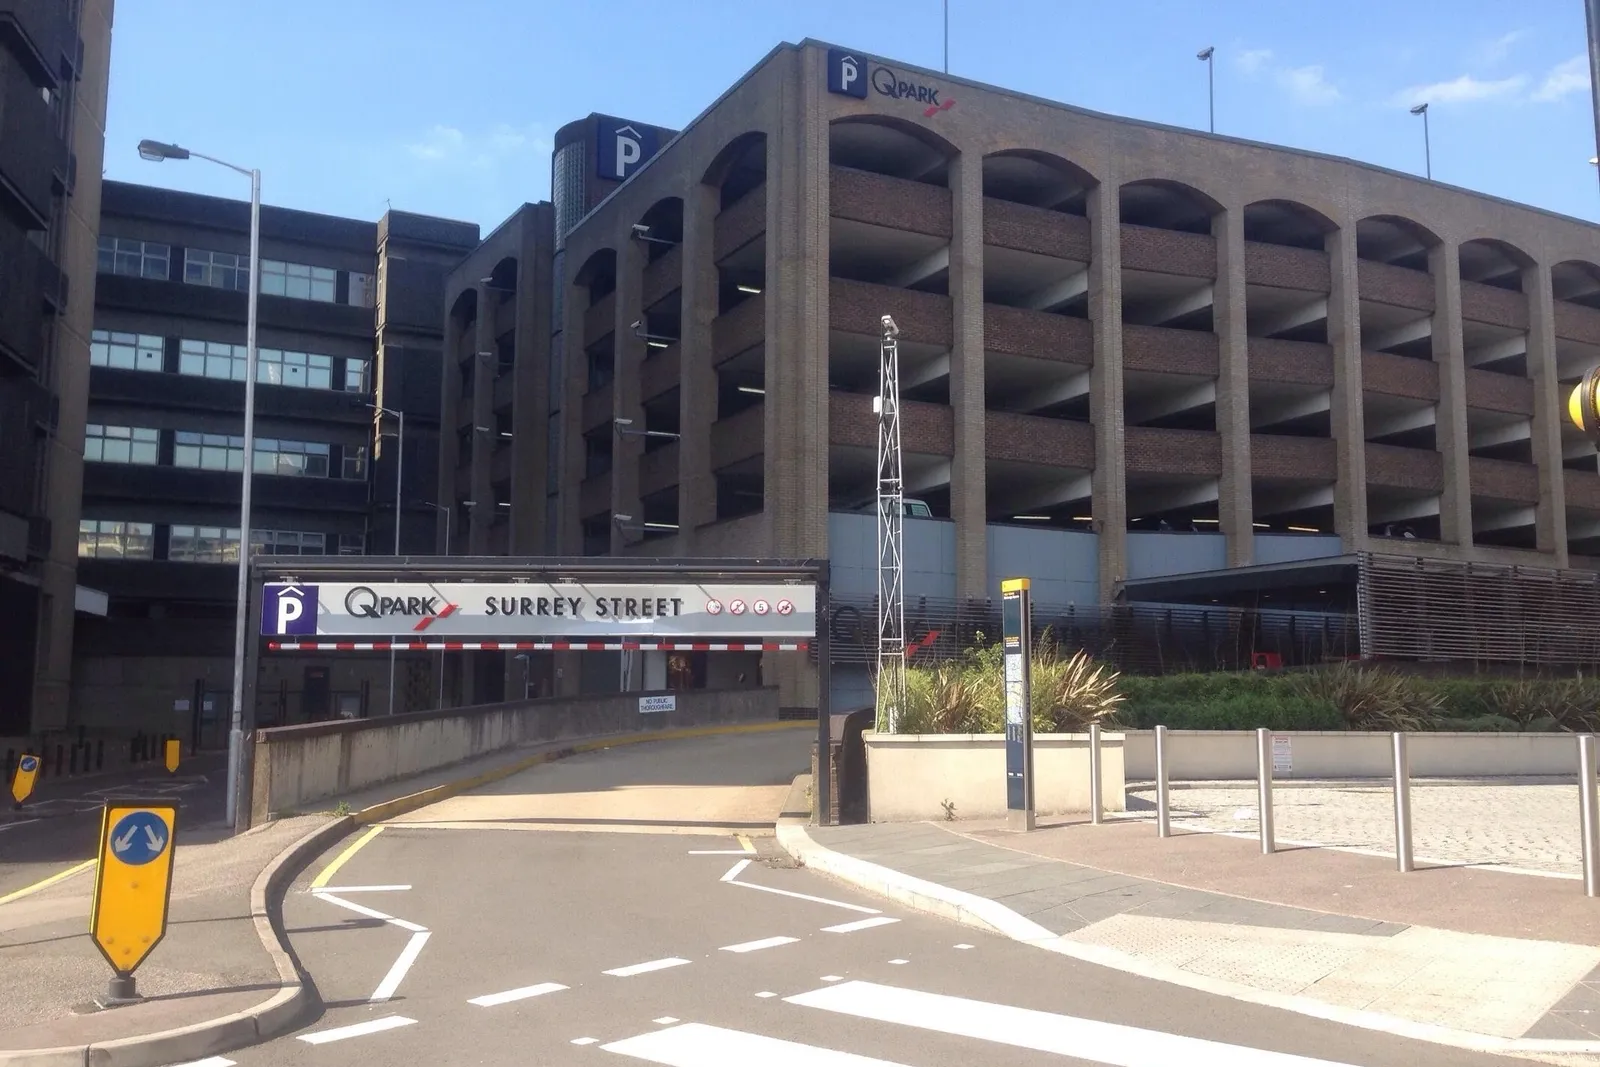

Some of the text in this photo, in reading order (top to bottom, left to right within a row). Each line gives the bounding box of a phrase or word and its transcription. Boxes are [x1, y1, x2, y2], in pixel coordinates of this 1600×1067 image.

[841, 62, 858, 91] P
[616, 135, 641, 177] P
[277, 596, 303, 635] P
[485, 596, 682, 617] SURREY STREET
